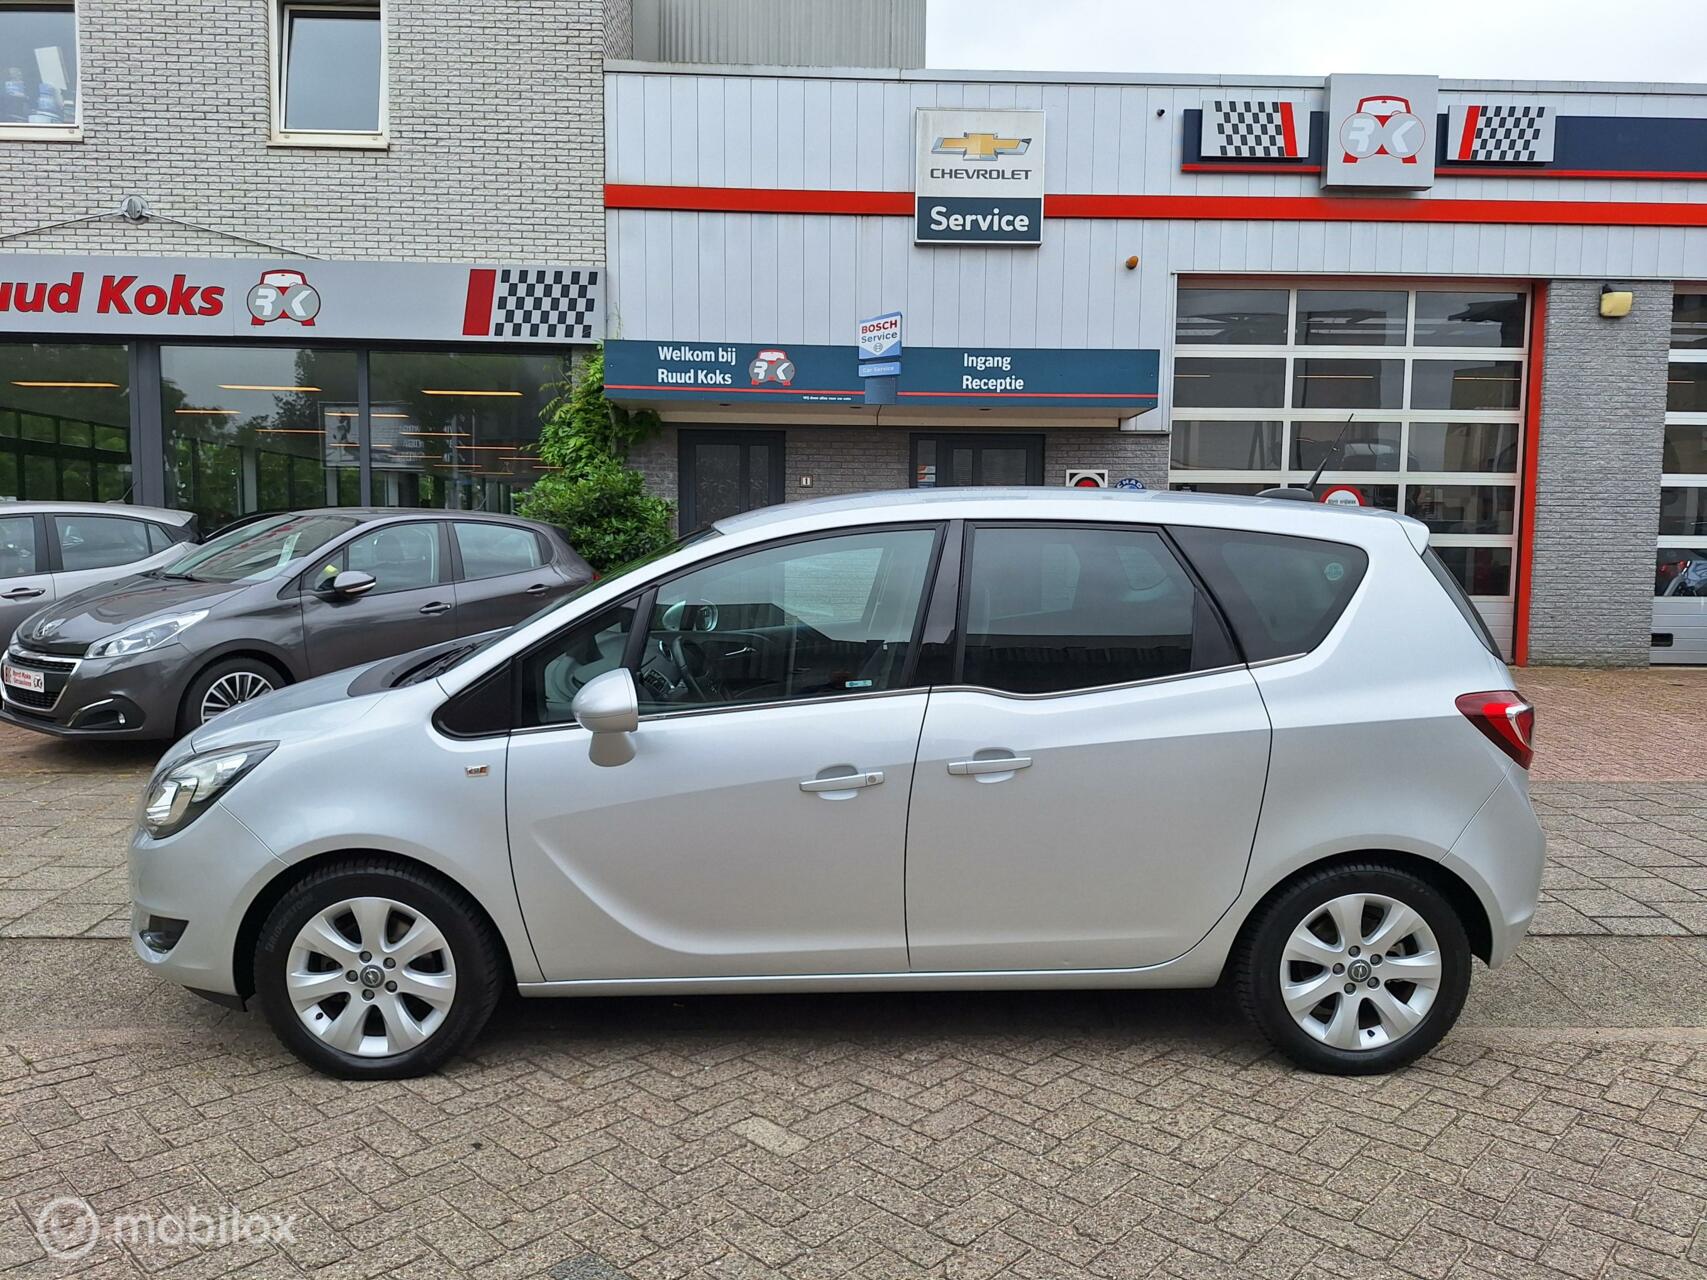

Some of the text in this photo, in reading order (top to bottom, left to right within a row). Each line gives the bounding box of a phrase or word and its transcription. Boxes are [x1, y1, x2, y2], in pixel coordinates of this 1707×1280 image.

[930, 168, 1032, 180] CHEVROLET
[930, 206, 1030, 231] Service
[97, 274, 226, 316] Koks
[861, 319, 898, 334] BOSCH
[861, 331, 898, 344] Service
[657, 345, 736, 366] Welkom bij
[963, 353, 1012, 371] Ingang
[657, 368, 732, 385] Ruud Koks
[962, 375, 1024, 393] Receptie
